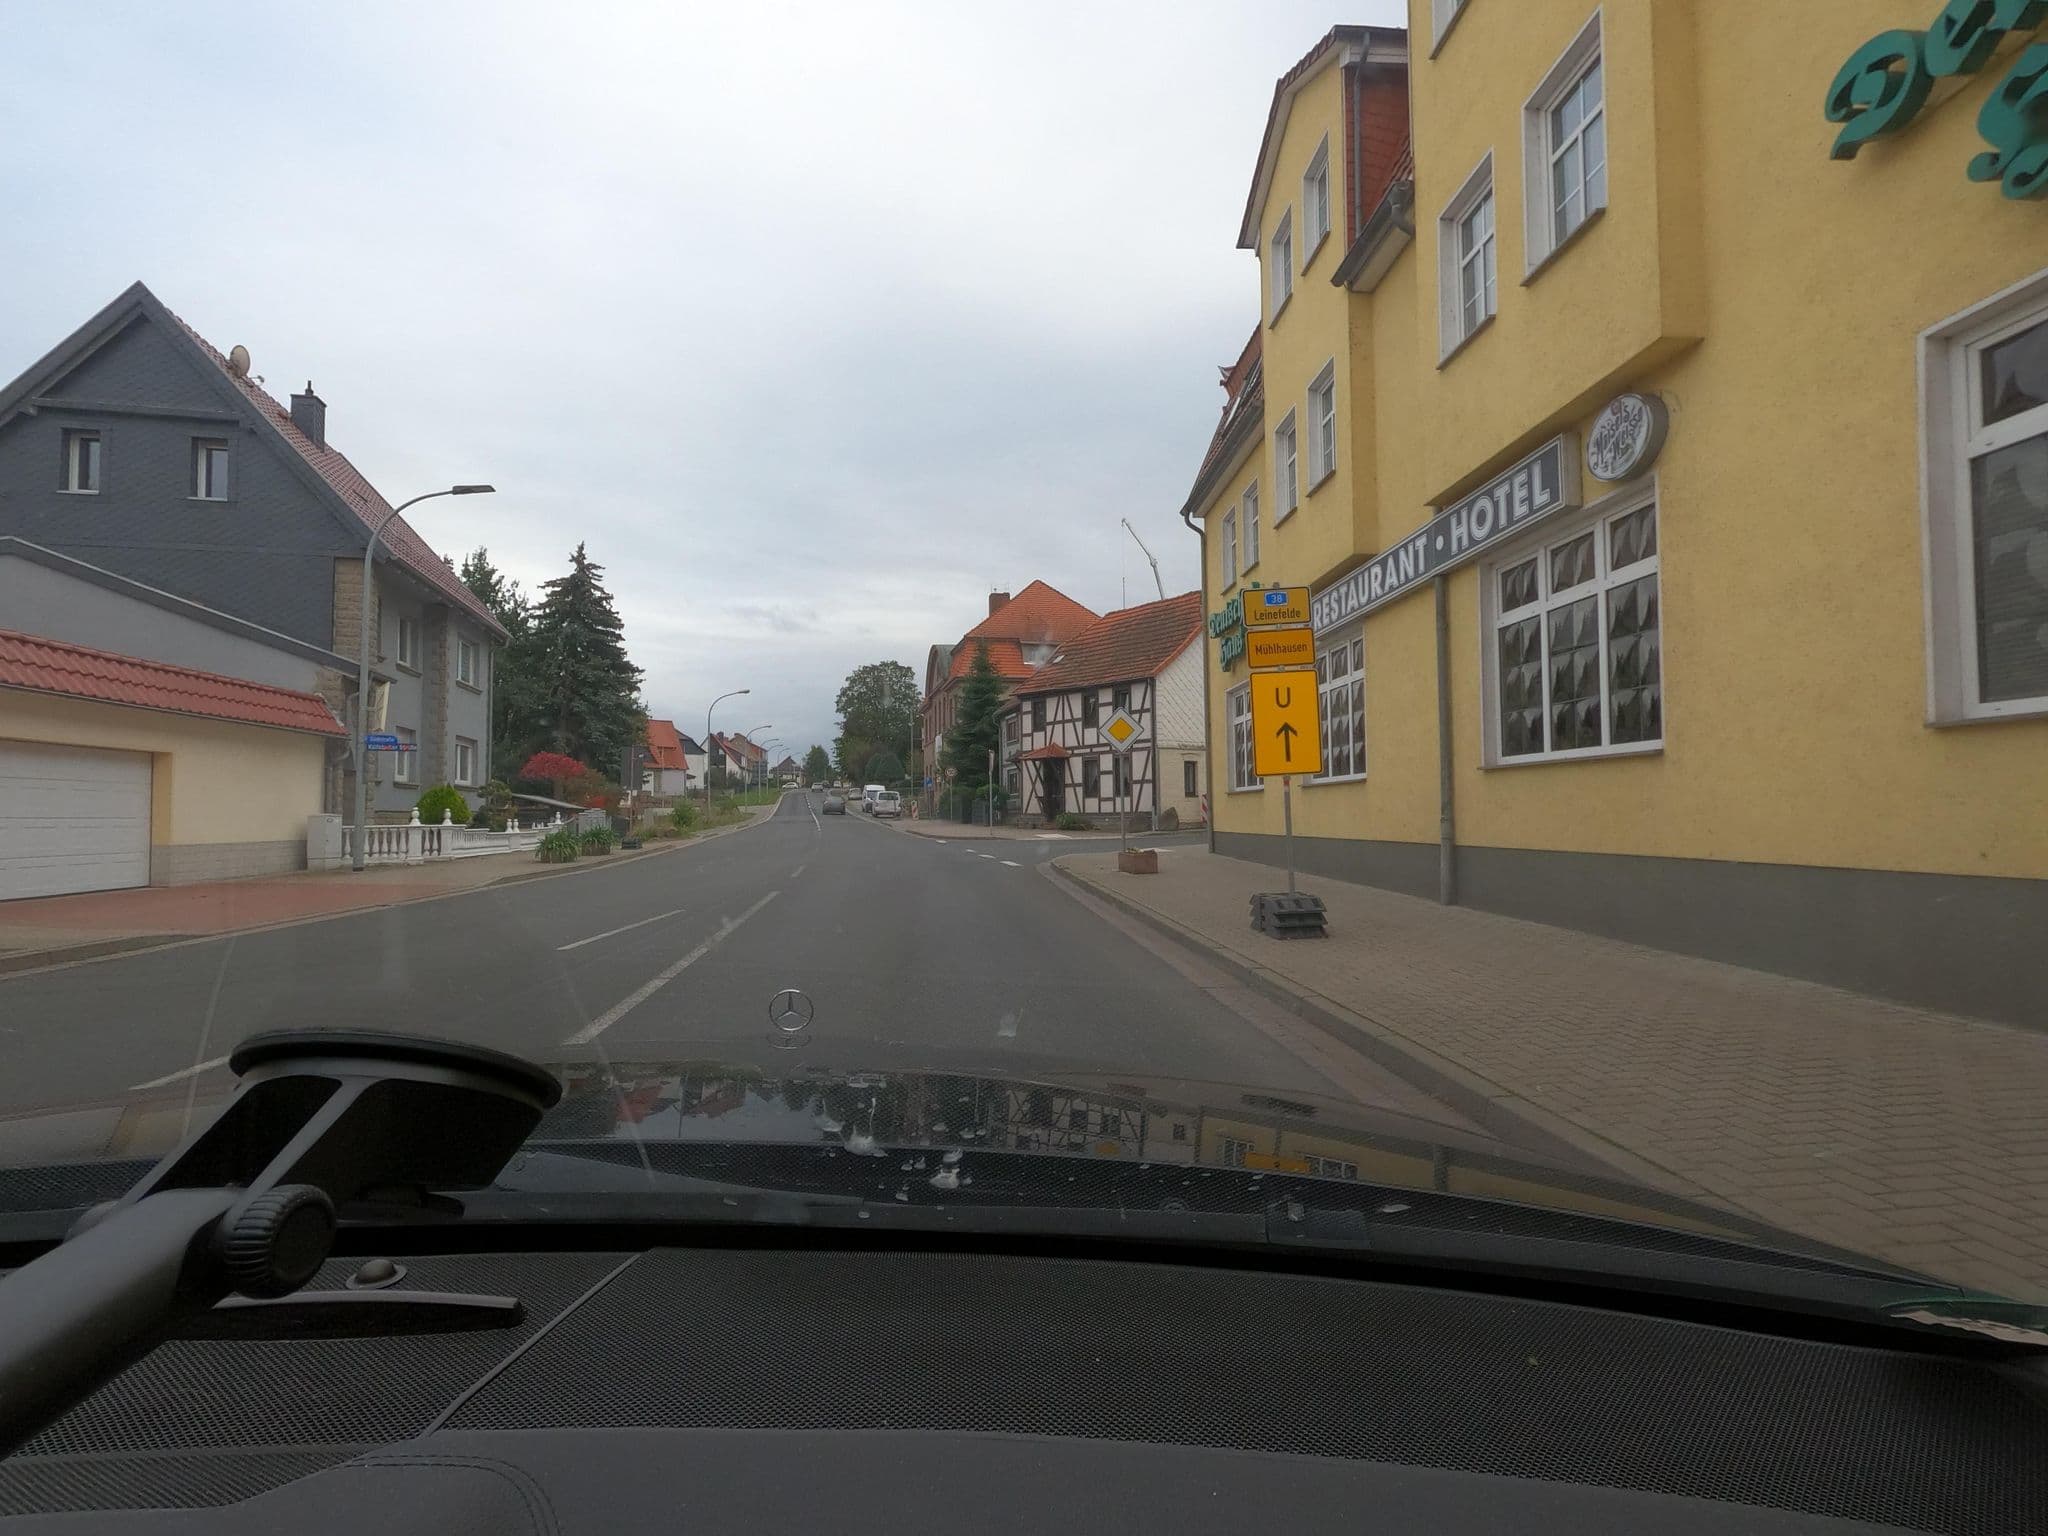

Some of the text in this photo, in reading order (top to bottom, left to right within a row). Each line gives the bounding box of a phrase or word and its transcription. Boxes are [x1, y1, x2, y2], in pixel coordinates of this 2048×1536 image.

[1313, 459, 1551, 630] RESTAURANT HOTEL
[1271, 594, 1283, 604] 38
[1254, 607, 1301, 621] Leinefelde
[1255, 642, 1308, 656] Mühlhausen
[1275, 686, 1291, 708] U
